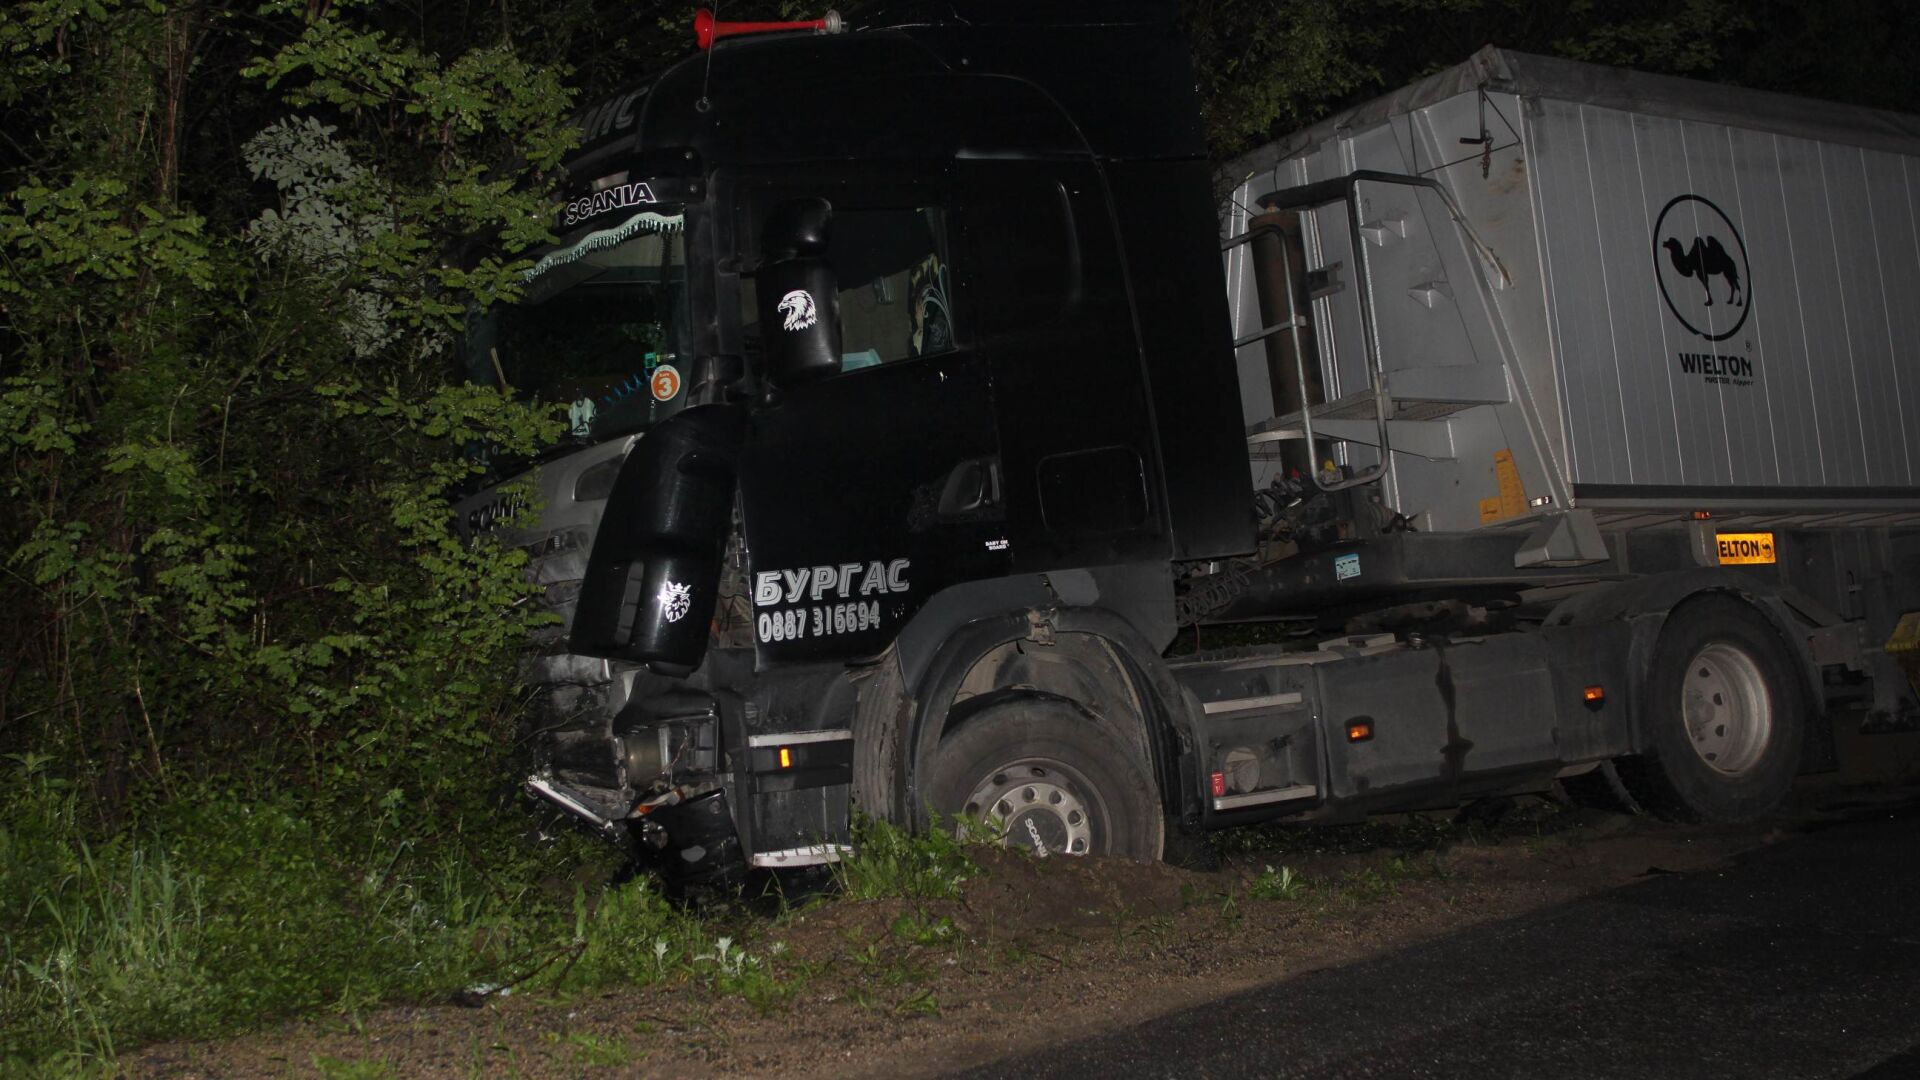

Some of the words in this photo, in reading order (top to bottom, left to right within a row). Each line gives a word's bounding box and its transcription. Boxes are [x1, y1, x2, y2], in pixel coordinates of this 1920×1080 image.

[566, 182, 656, 225] SCANIA
[1679, 353, 1753, 377] WIELTON
[658, 377, 672, 397] 3
[1717, 540, 1760, 557] ELTON
[754, 557, 911, 606] БУРГАС
[758, 607, 807, 643] 0887
[812, 600, 881, 637] 316694
